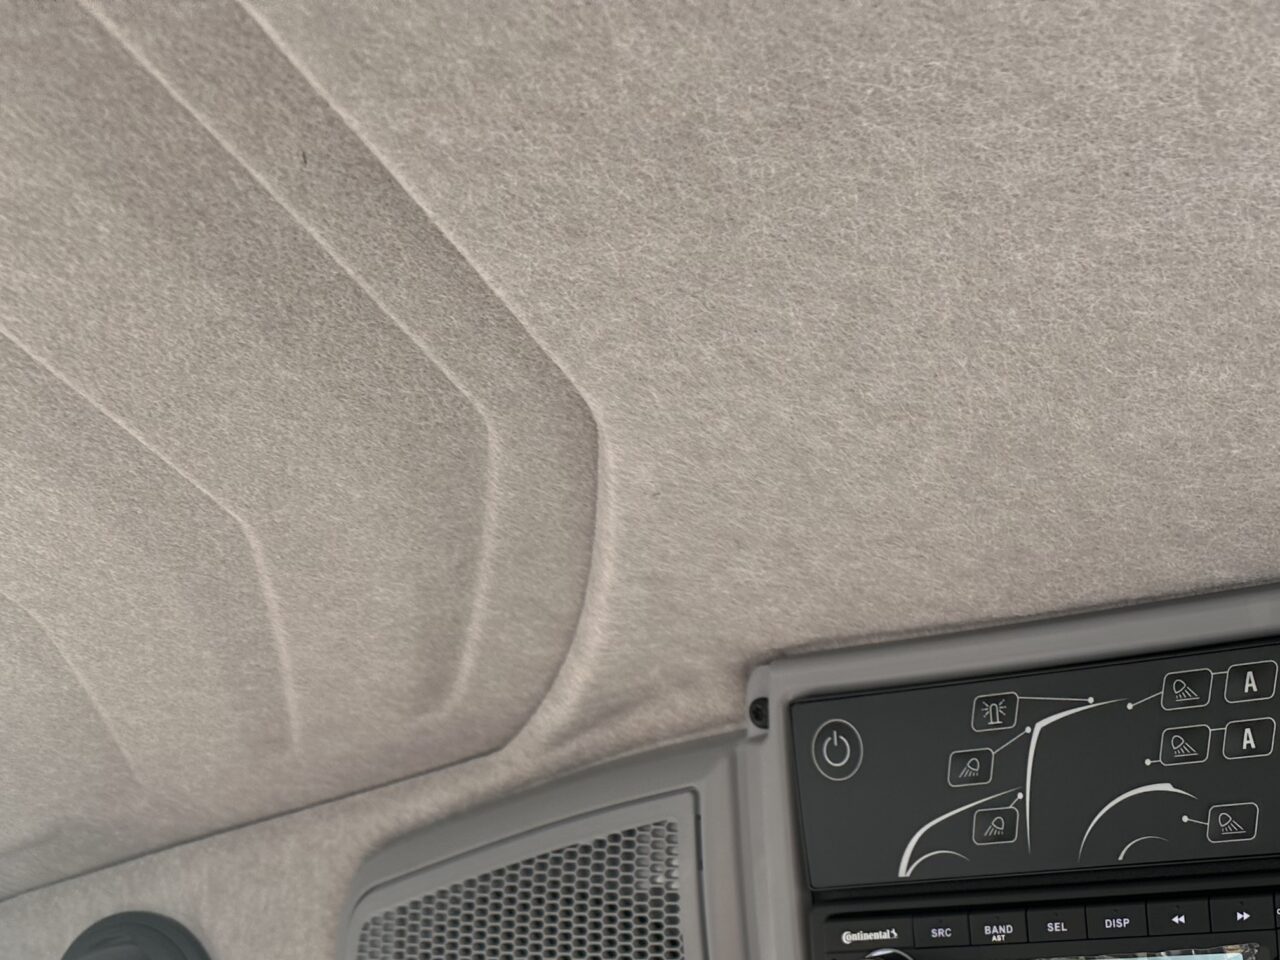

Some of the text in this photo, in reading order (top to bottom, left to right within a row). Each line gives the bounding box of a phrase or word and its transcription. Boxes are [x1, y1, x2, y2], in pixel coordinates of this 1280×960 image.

[1244, 670, 1258, 693] A
[1242, 727, 1256, 750] A
[1047, 921, 1068, 932] SEL
[1104, 917, 1130, 929] DISP
[931, 927, 952, 939] SRC
[984, 924, 1014, 936] BAND
[841, 929, 891, 945] Continental
[991, 933, 1006, 942] AST
